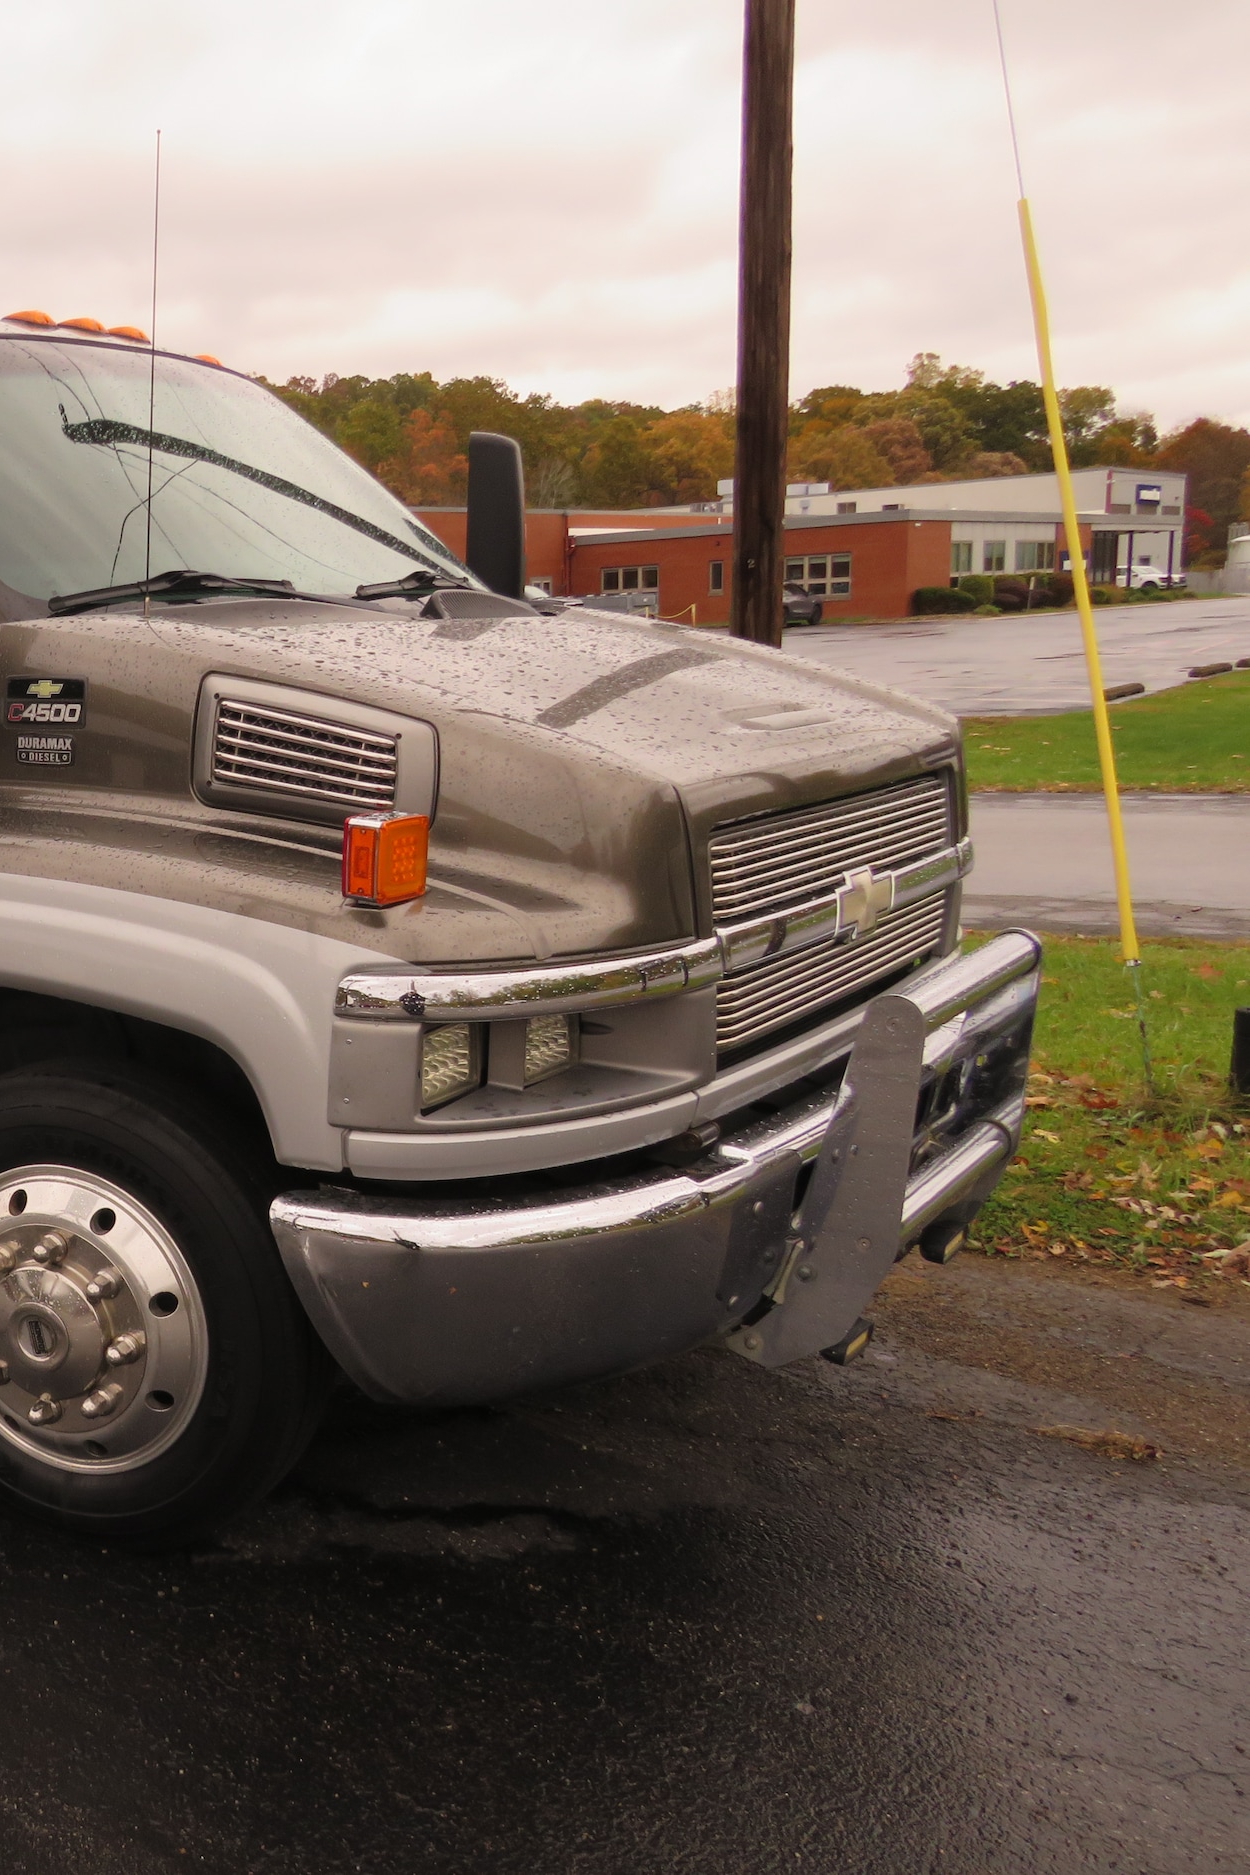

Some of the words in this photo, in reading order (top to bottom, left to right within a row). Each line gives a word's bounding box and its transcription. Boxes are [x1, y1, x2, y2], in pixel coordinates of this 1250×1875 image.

[747, 558, 756, 569] 2
[7, 703, 82, 723] C4500
[17, 736, 72, 750] DURAMAX
[29, 752, 61, 762] DIESEL
